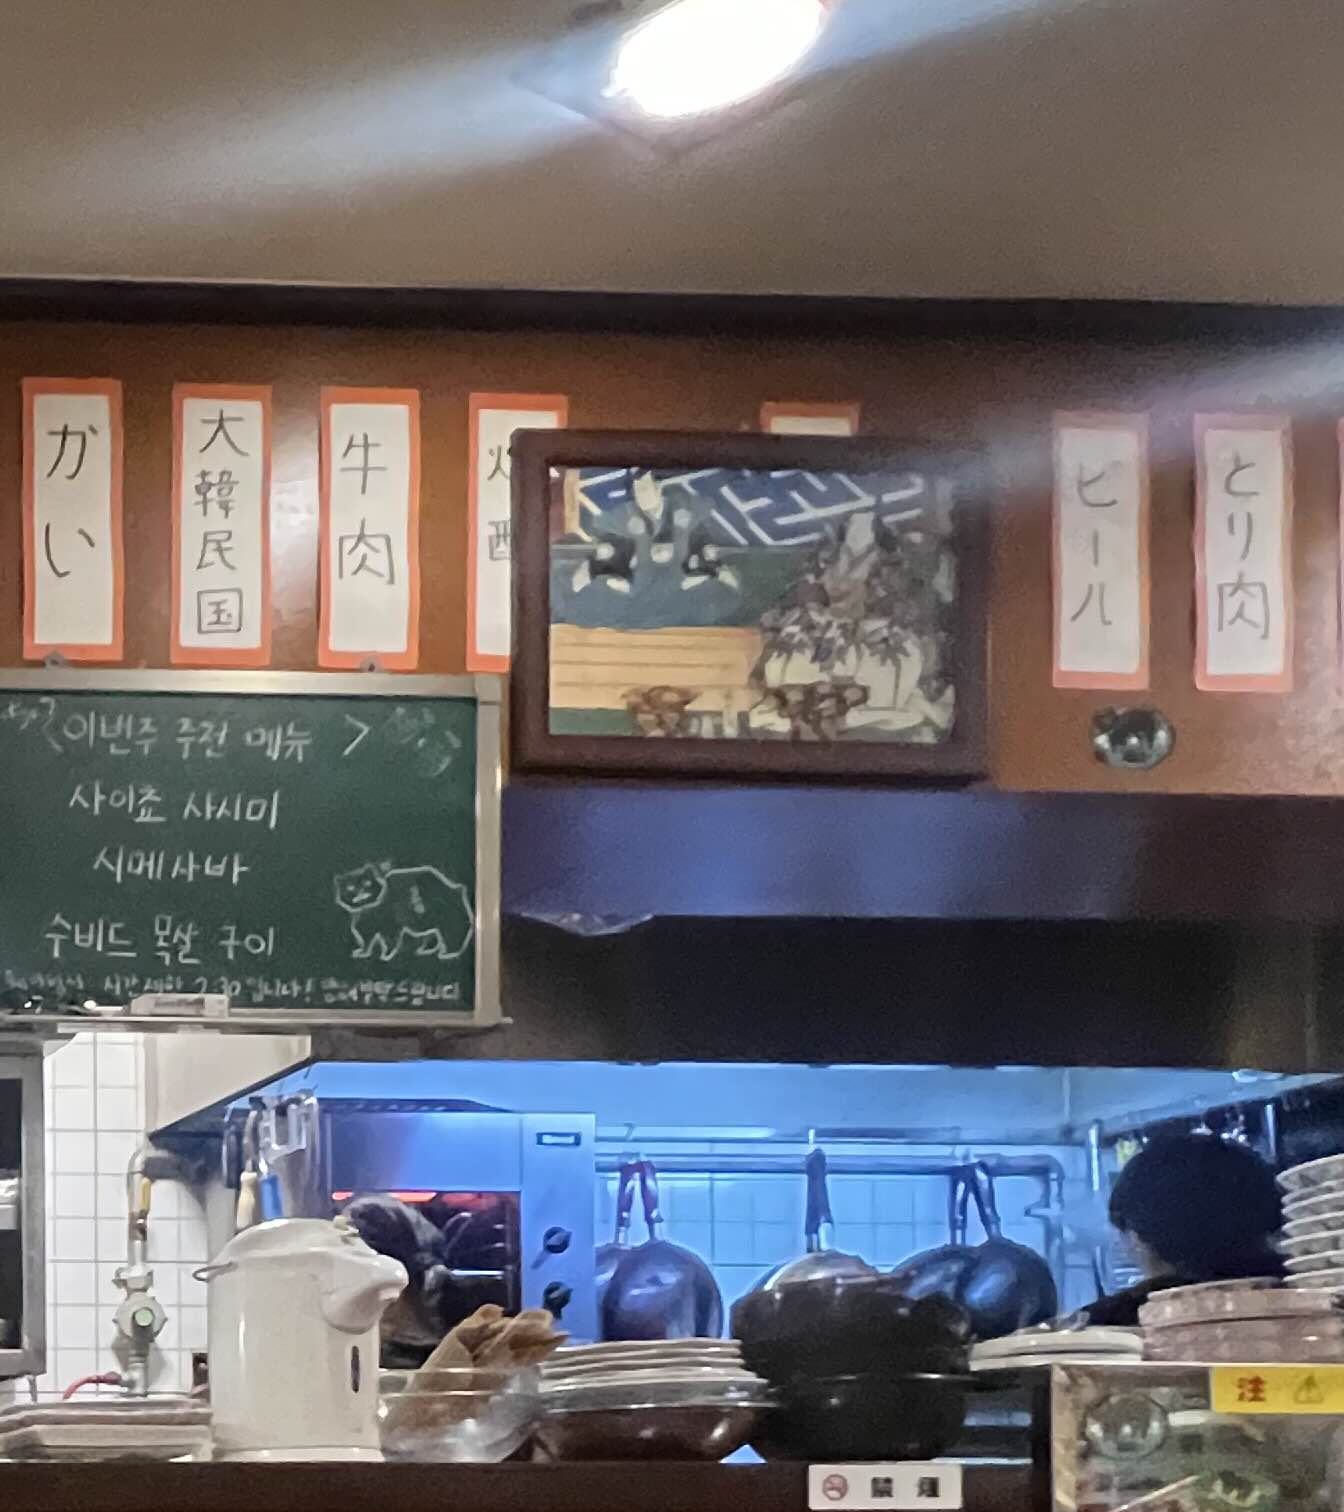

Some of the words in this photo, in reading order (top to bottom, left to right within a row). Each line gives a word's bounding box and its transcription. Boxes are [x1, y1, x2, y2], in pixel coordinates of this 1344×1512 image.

[193, 408, 250, 636] 大韓民国
[336, 431, 396, 586] 牛肉
[1216, 452, 1271, 641] とり肉
[63, 711, 157, 755] 이번주
[244, 720, 313, 763] 메뉴
[182, 789, 280, 830] 사시미
[93, 845, 250, 885] 시메사바
[45, 912, 138, 959] 수비드
[218, 924, 275, 961] 구이
